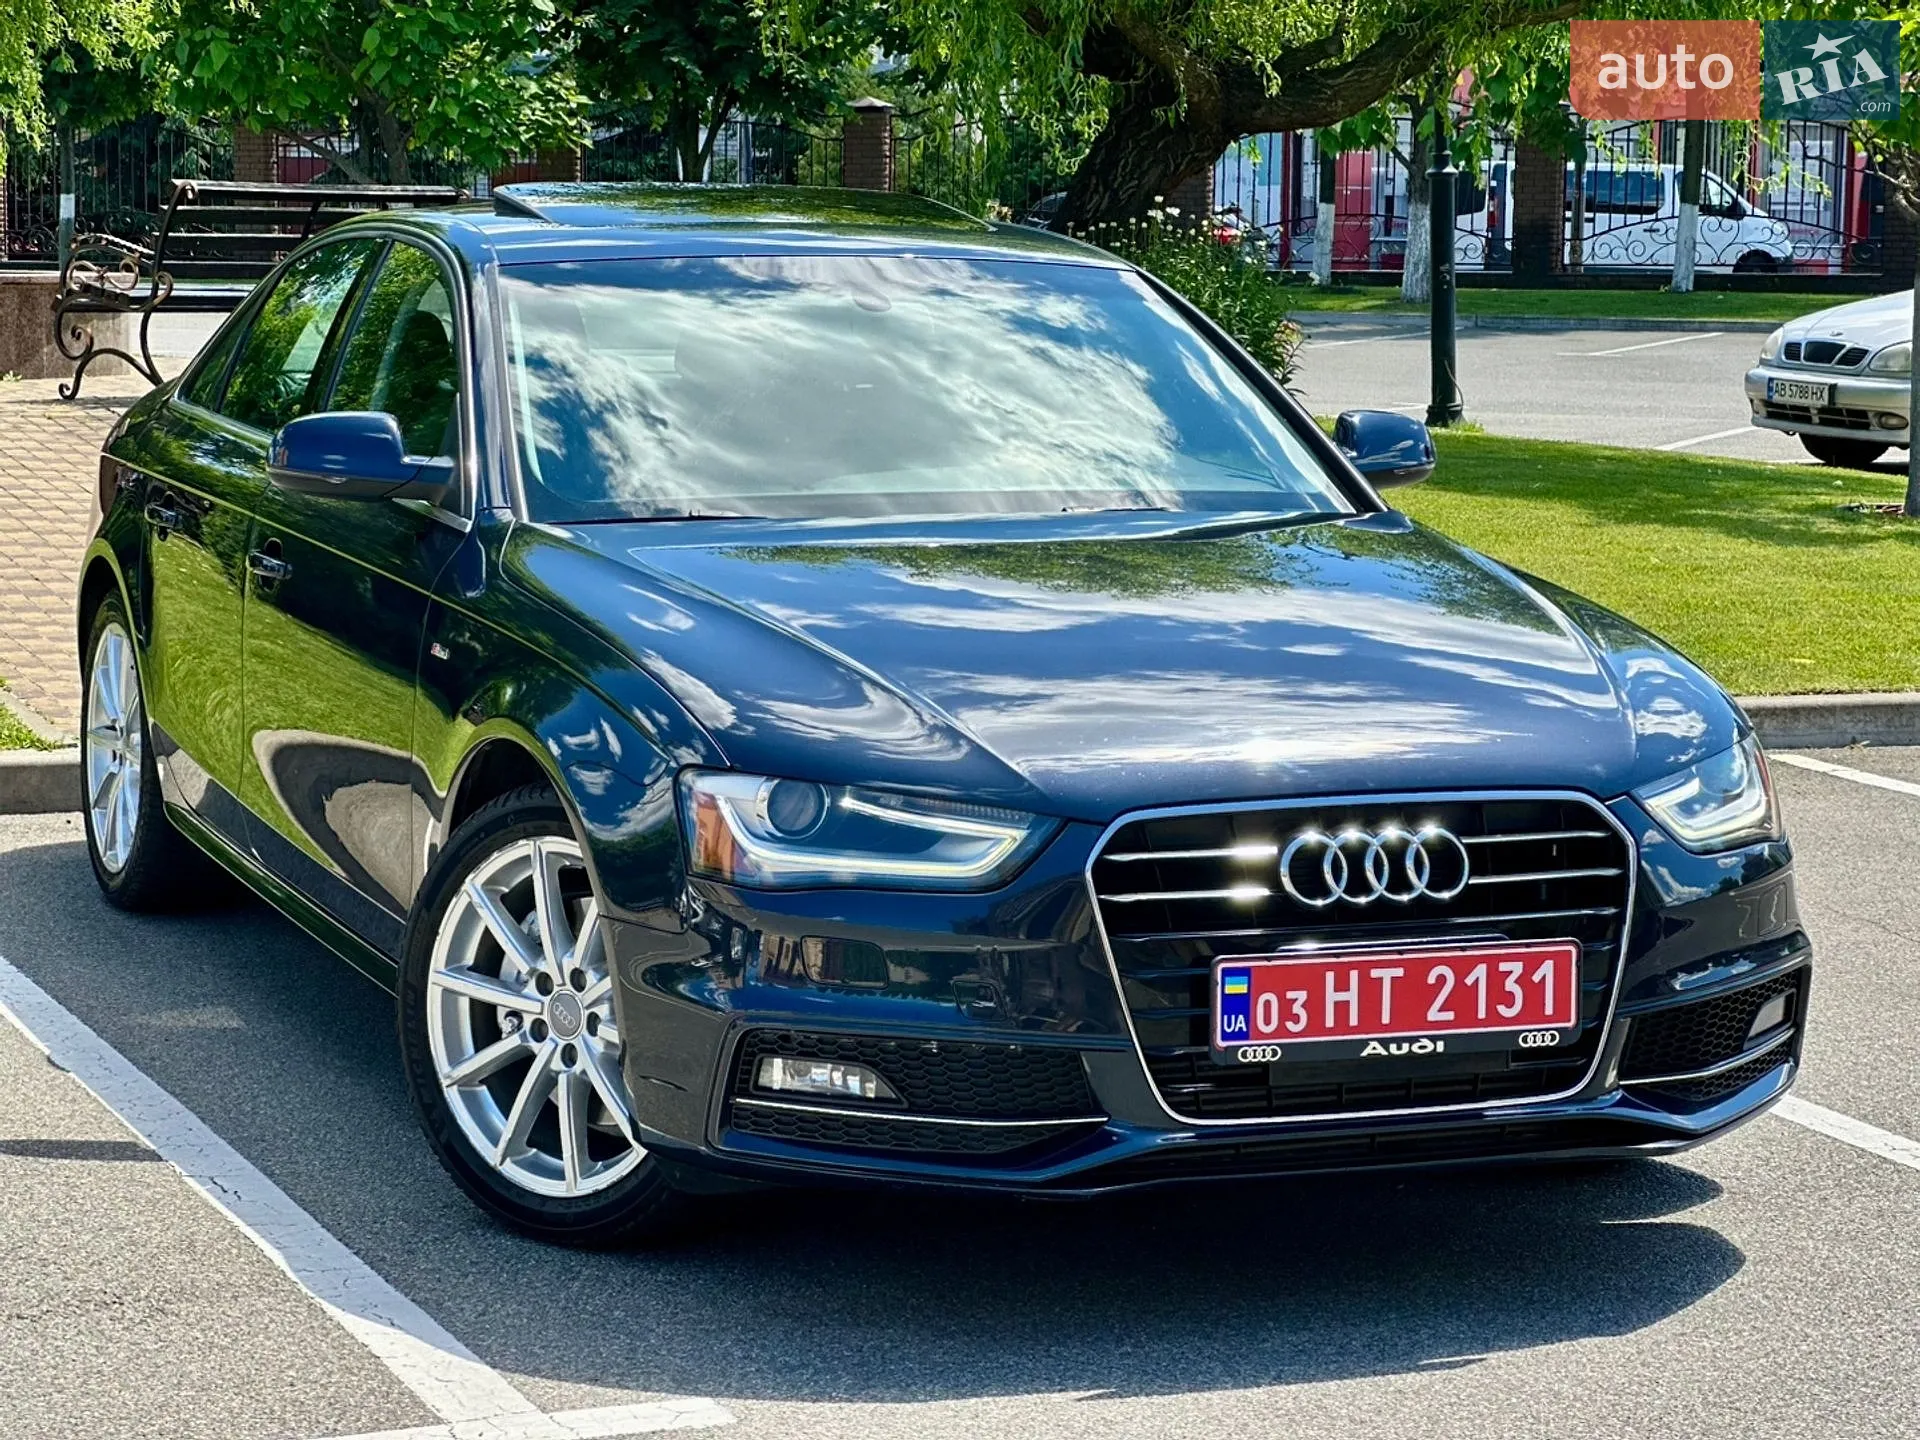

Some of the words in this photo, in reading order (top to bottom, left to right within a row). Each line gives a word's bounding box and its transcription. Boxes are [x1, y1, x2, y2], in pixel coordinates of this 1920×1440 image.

[1774, 382, 1787, 397] AB
[1255, 990, 1308, 1034] 03
[1324, 967, 1405, 1029] HT
[1426, 959, 1555, 1023] 2131
[1223, 1014, 1247, 1033] UA
[1359, 1038, 1444, 1057] Audi
